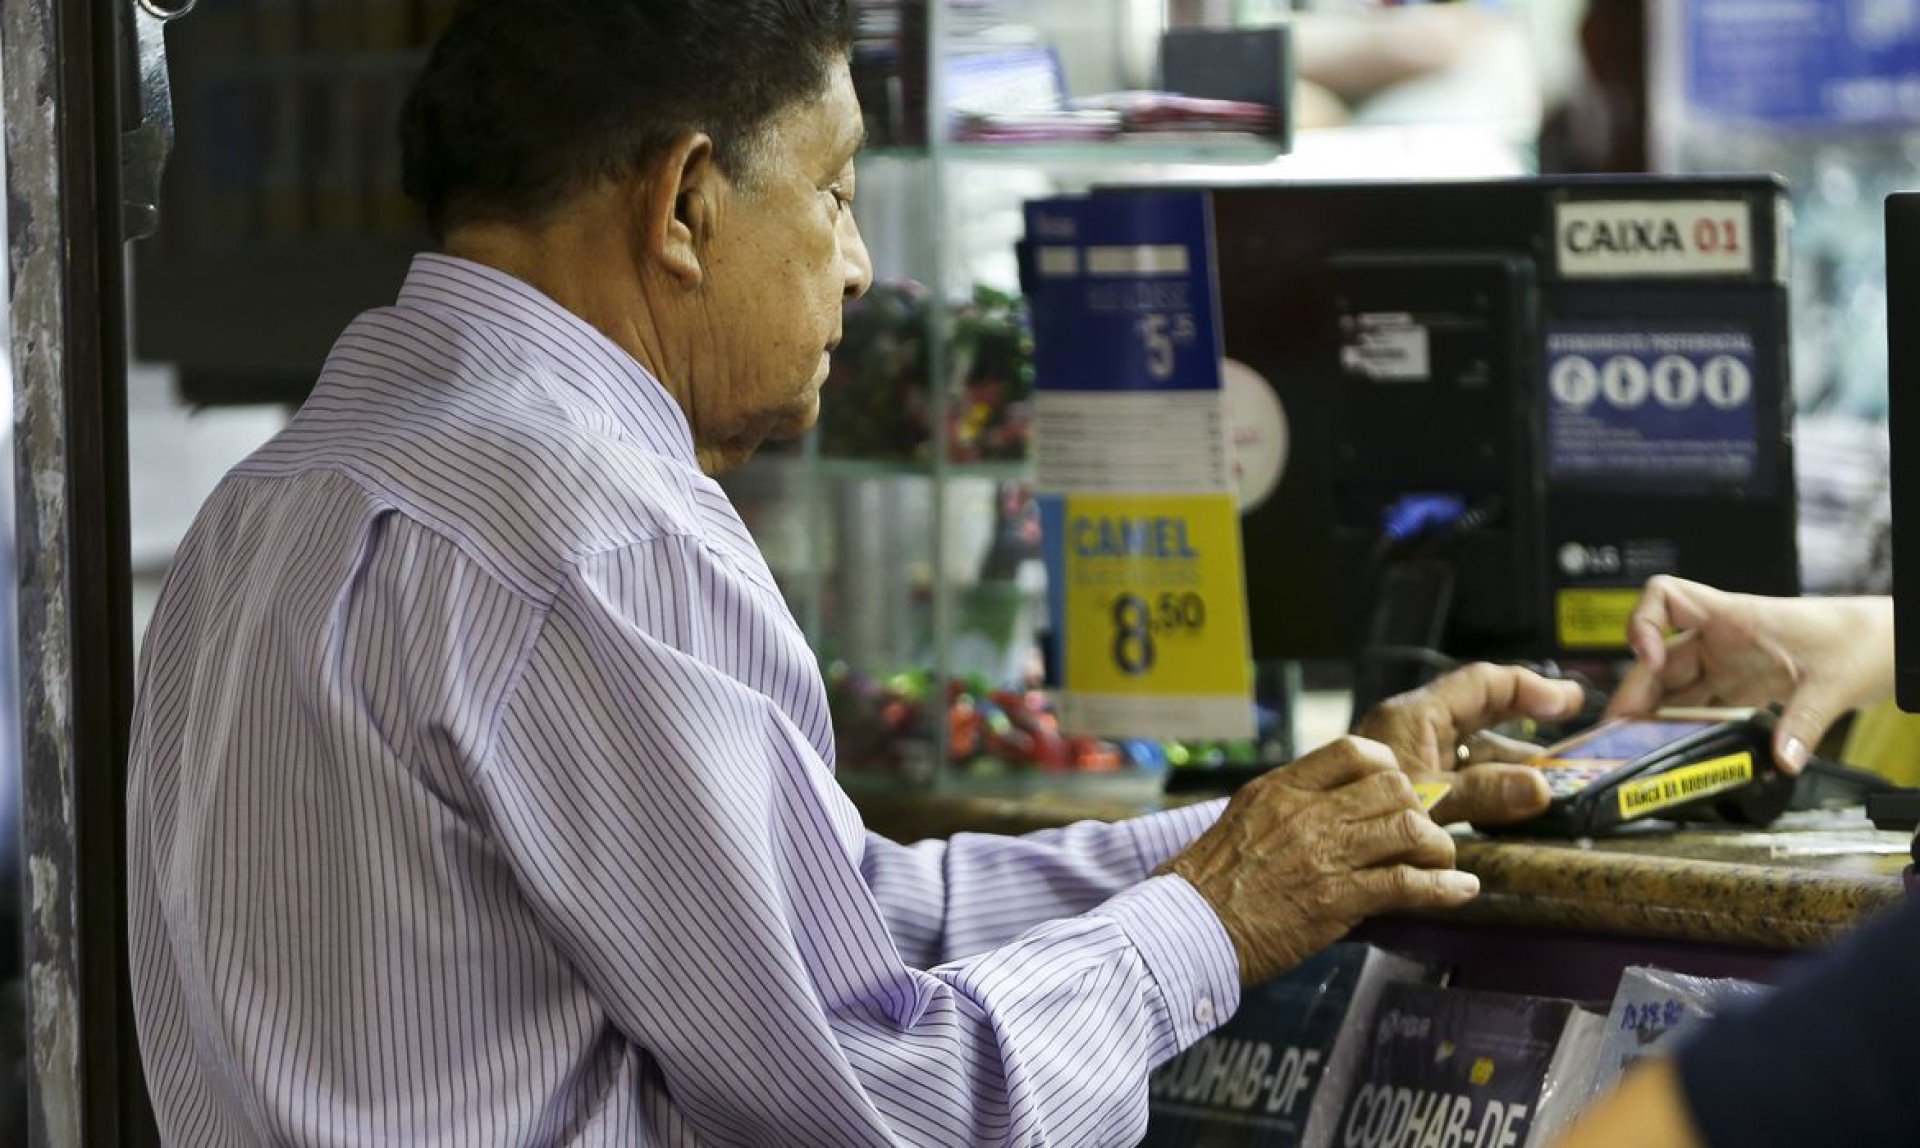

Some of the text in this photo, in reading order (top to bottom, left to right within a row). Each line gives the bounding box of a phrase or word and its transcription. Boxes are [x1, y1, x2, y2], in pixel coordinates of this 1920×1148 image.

[1565, 217, 1739, 254] CAIXA 01
[1071, 516, 1197, 557] CAMEL
